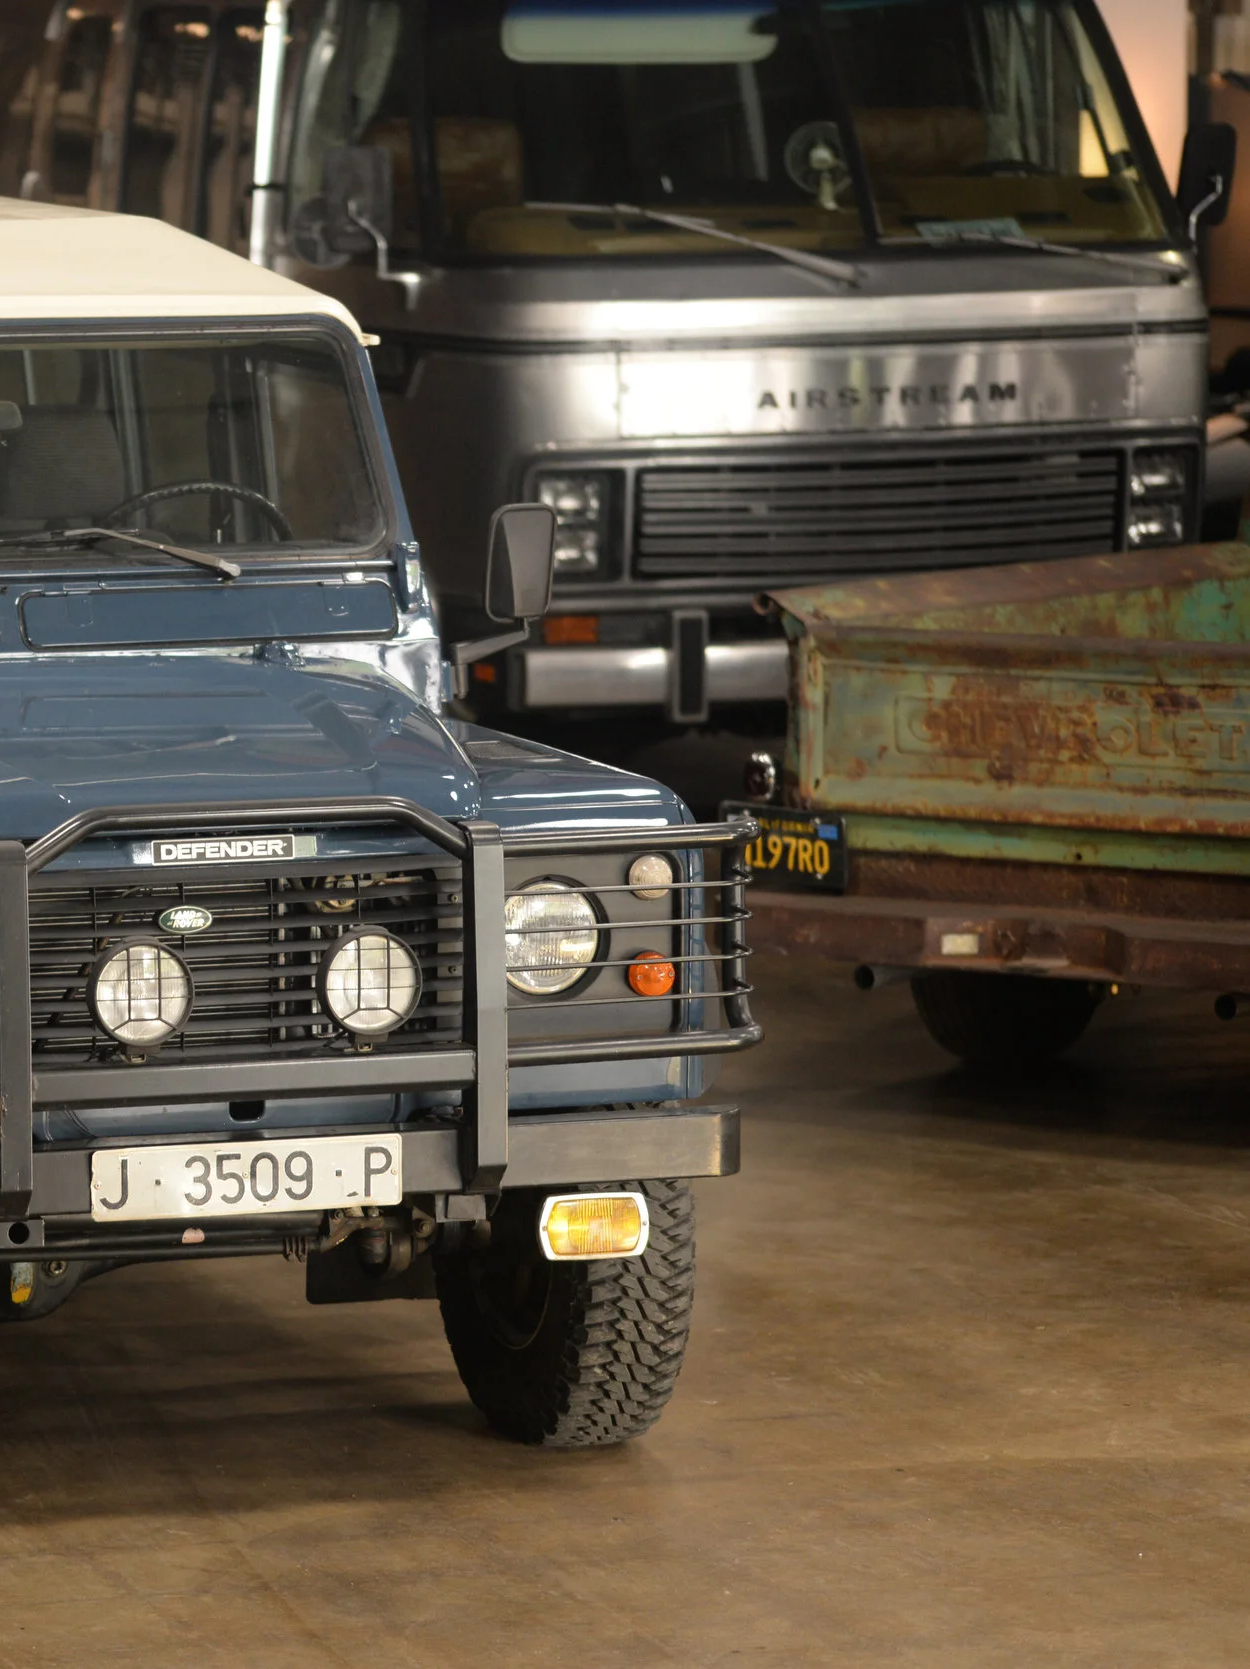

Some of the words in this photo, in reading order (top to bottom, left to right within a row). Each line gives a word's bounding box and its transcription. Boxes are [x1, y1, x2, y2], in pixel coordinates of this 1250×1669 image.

[757, 382, 1017, 409] AIRSTREAM
[160, 839, 285, 861] DEFENDER
[170, 910, 197, 920] LAND
[172, 918, 205, 929] ROVER
[99, 1158, 129, 1210] J
[183, 1150, 314, 1207] 3509
[363, 1146, 393, 1198] P
